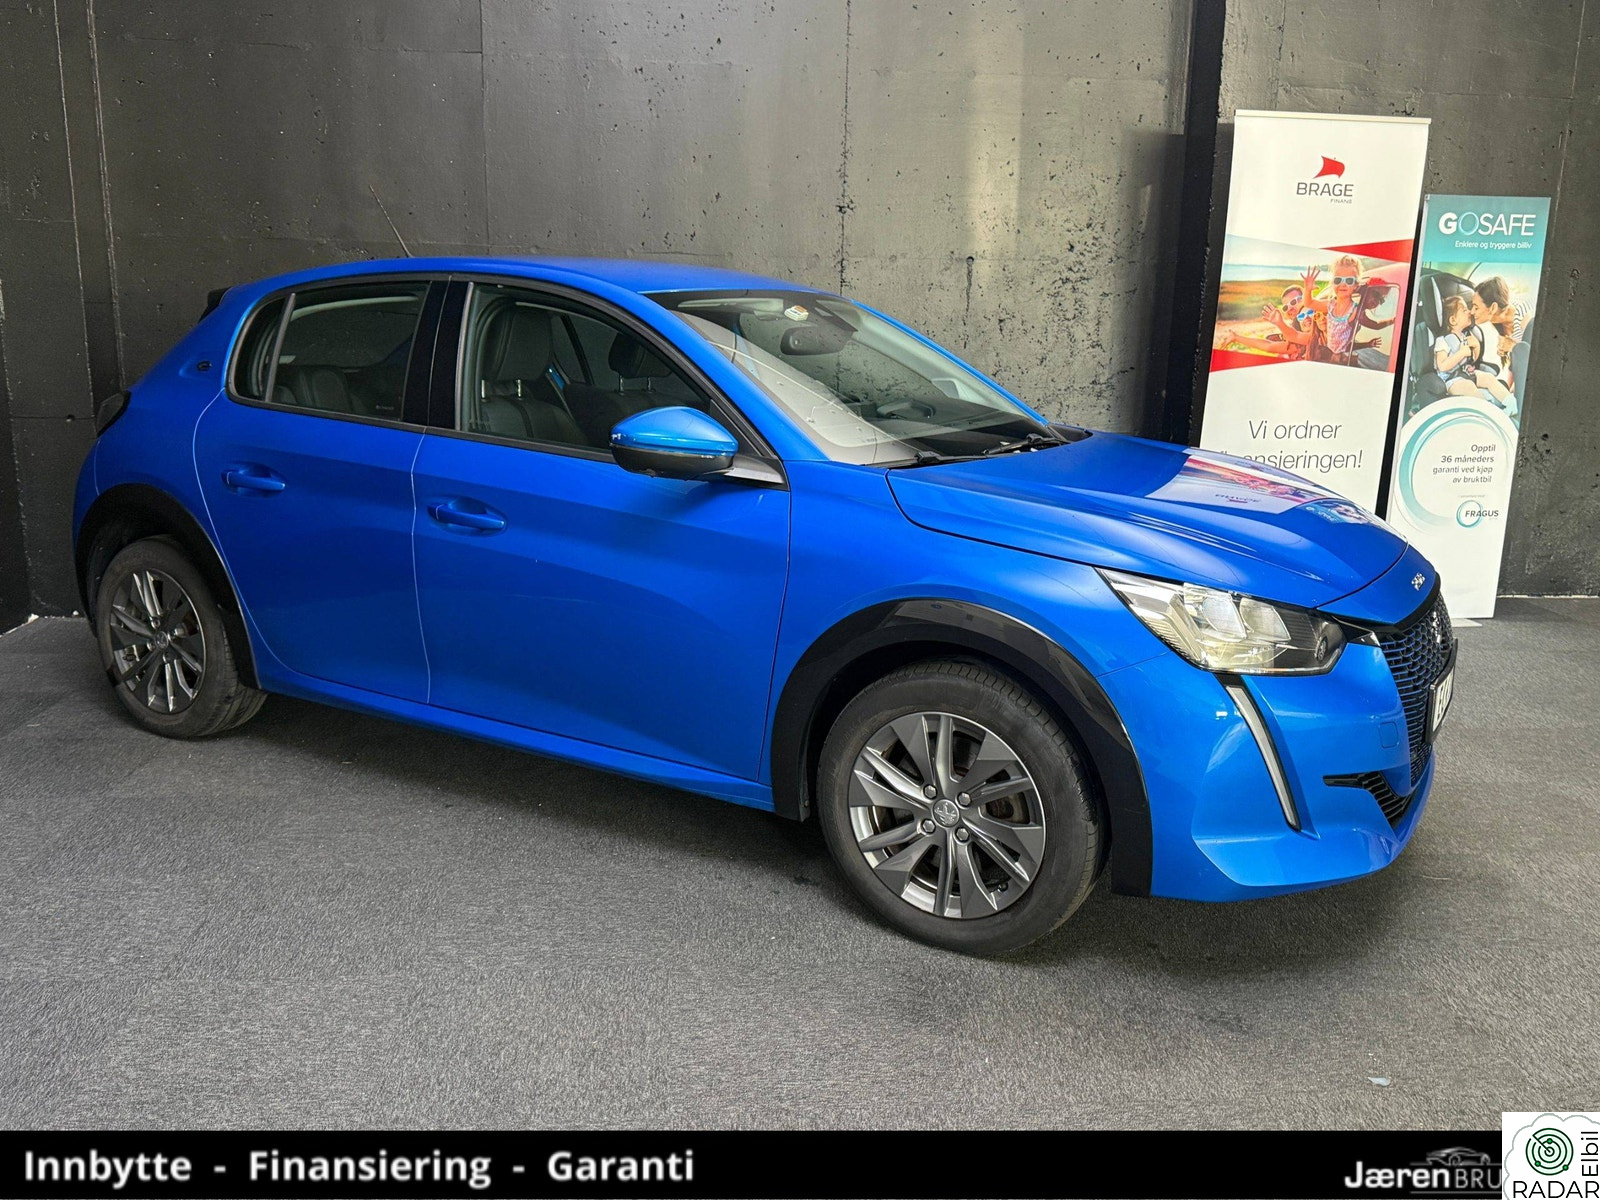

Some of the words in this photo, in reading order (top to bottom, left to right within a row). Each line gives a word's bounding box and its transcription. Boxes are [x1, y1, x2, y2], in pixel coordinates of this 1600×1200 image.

[1296, 182, 1354, 197] BRAGE
[1438, 211, 1537, 236] GOSAFE
[1455, 240, 1479, 248] Enklere
[1489, 241, 1516, 250] tryggere
[1249, 420, 1268, 439] Vi
[1274, 420, 1342, 439] ordner
[1470, 444, 1496, 454] Opptil
[1441, 455, 1453, 463] 36
[1454, 455, 1494, 463] måneders
[1432, 466, 1459, 475] garanti
[1477, 466, 1493, 475] kjøp
